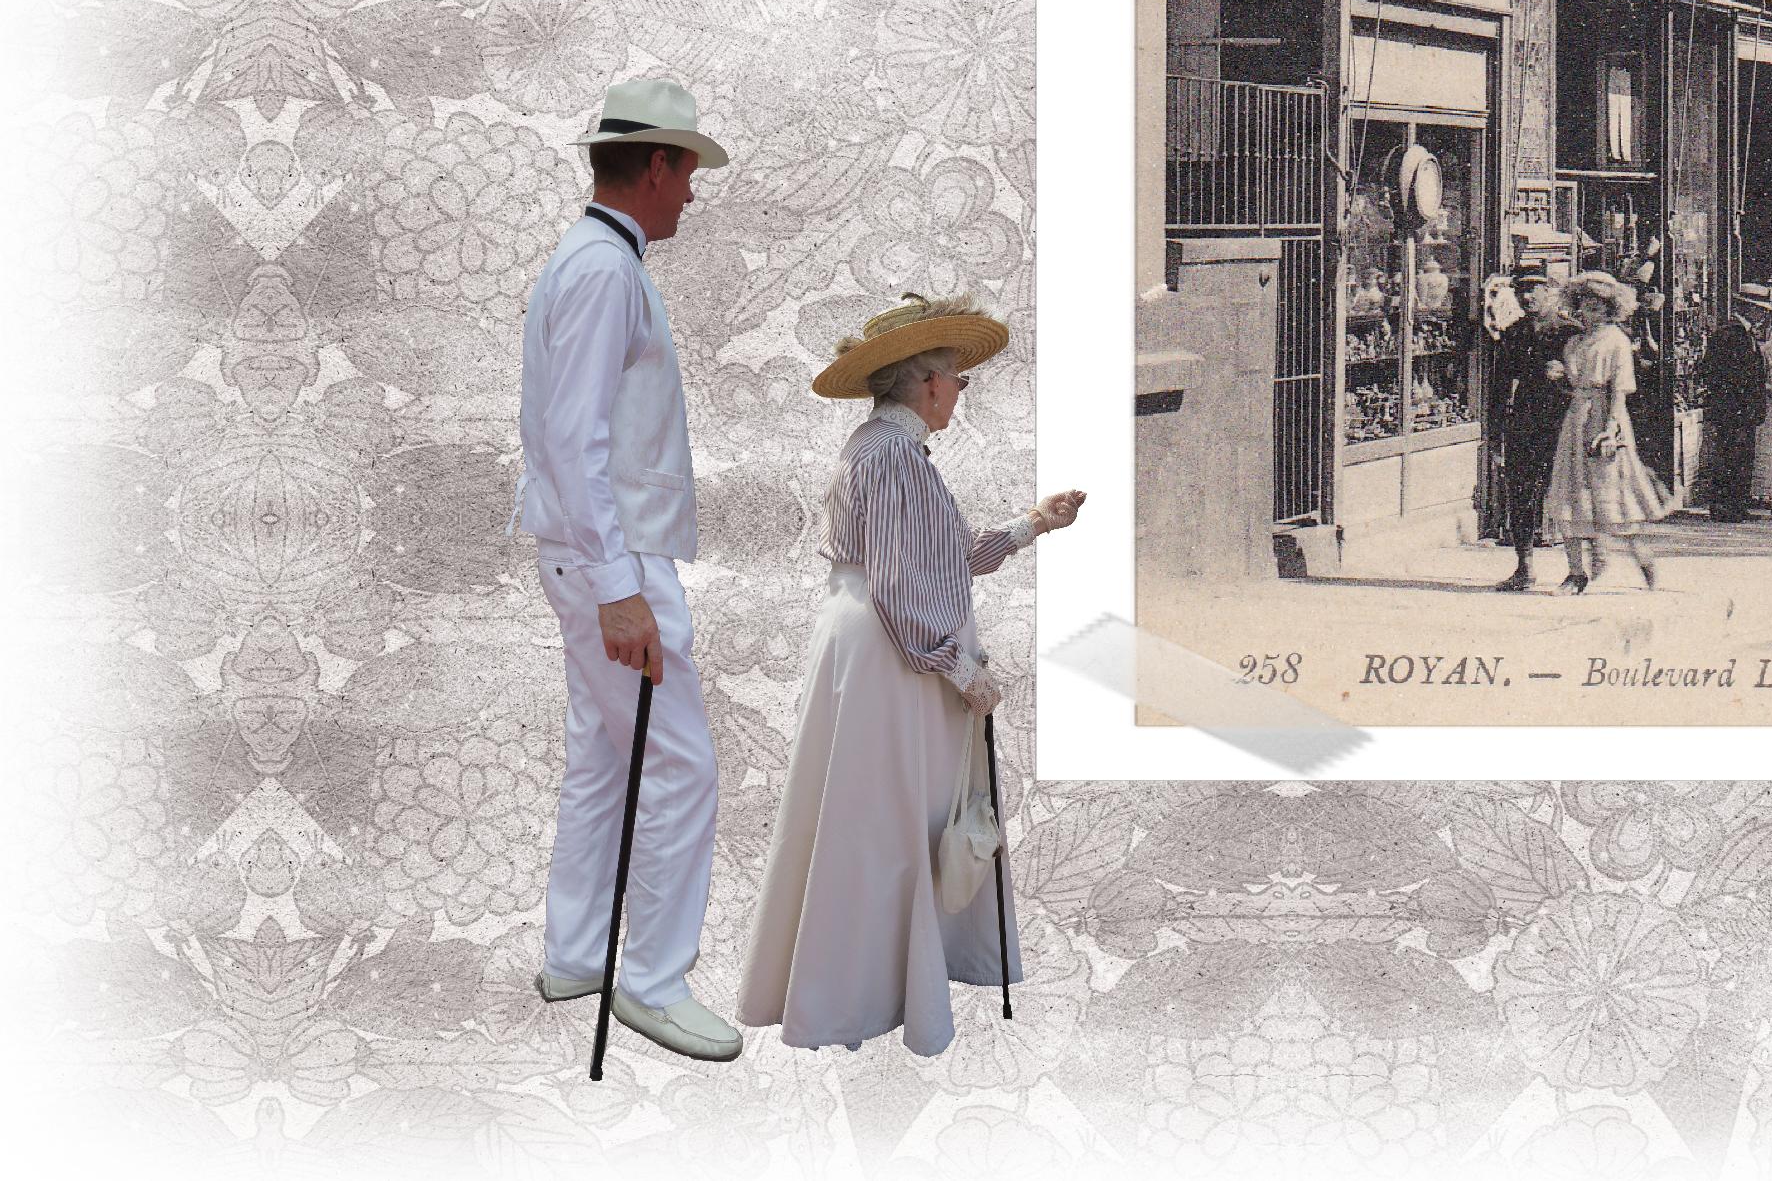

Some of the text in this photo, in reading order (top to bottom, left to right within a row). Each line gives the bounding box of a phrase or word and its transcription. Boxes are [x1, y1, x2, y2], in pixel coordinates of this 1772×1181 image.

[1235, 652, 1302, 685] 258
[1359, 653, 1511, 686] ROYAN.
[1582, 657, 1737, 688] Boulevard
